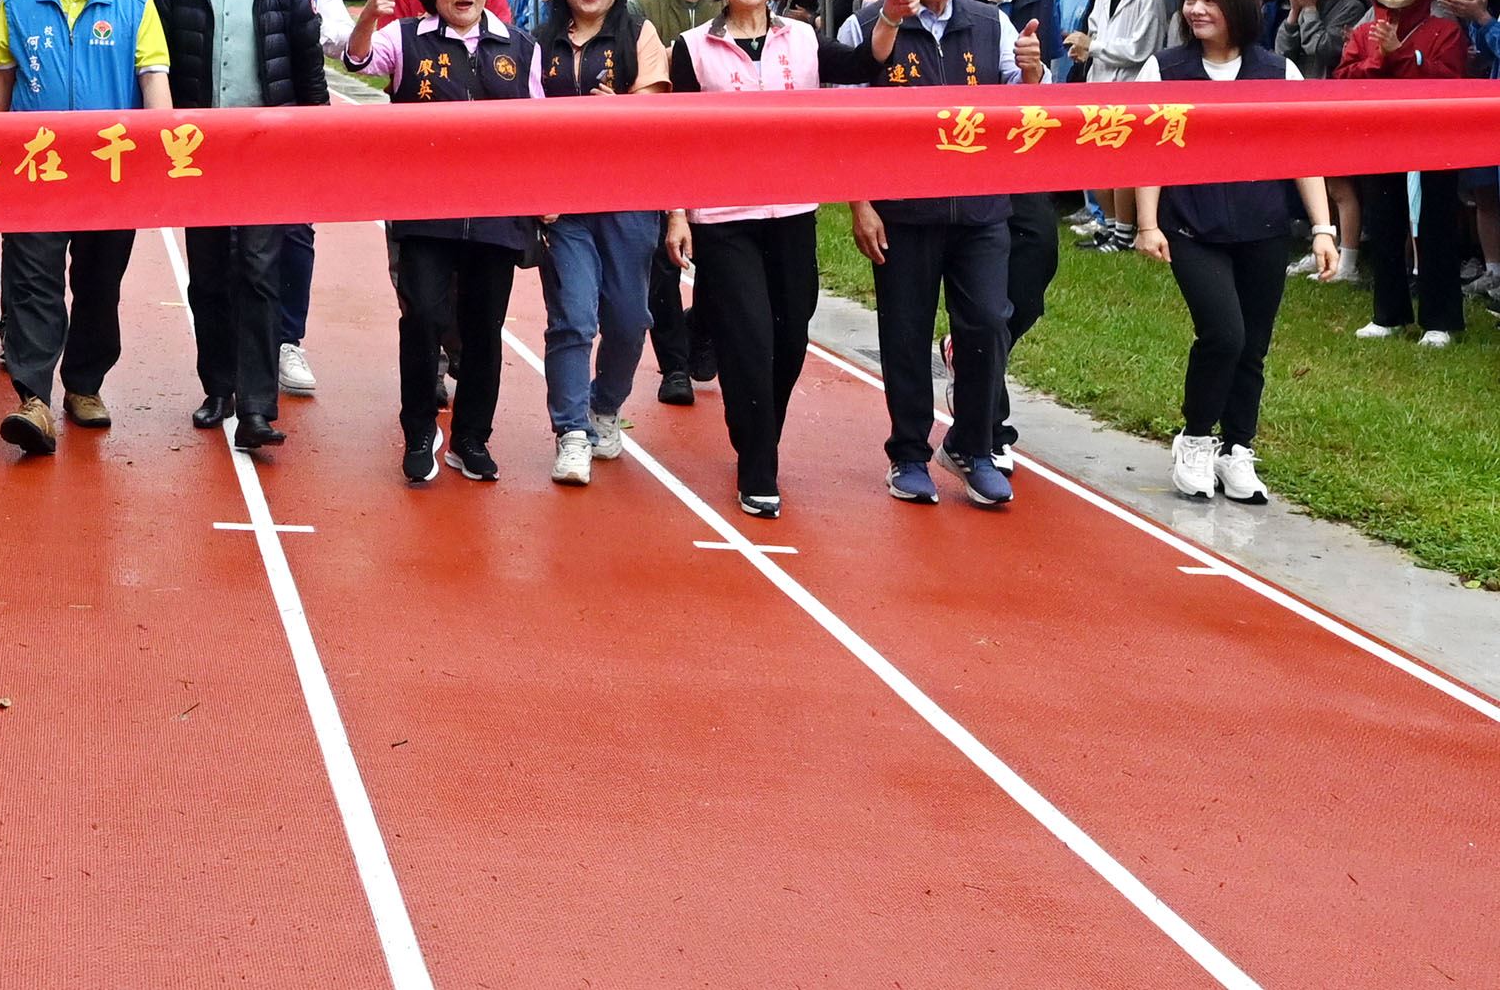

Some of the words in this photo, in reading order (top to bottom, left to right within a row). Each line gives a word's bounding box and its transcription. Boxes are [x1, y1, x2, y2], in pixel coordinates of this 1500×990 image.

[44, 26, 53, 49] 校長
[26, 35, 41, 93] 何高志
[438, 53, 451, 79] 議員
[887, 63, 908, 83] 連
[416, 58, 436, 100] 廖英
